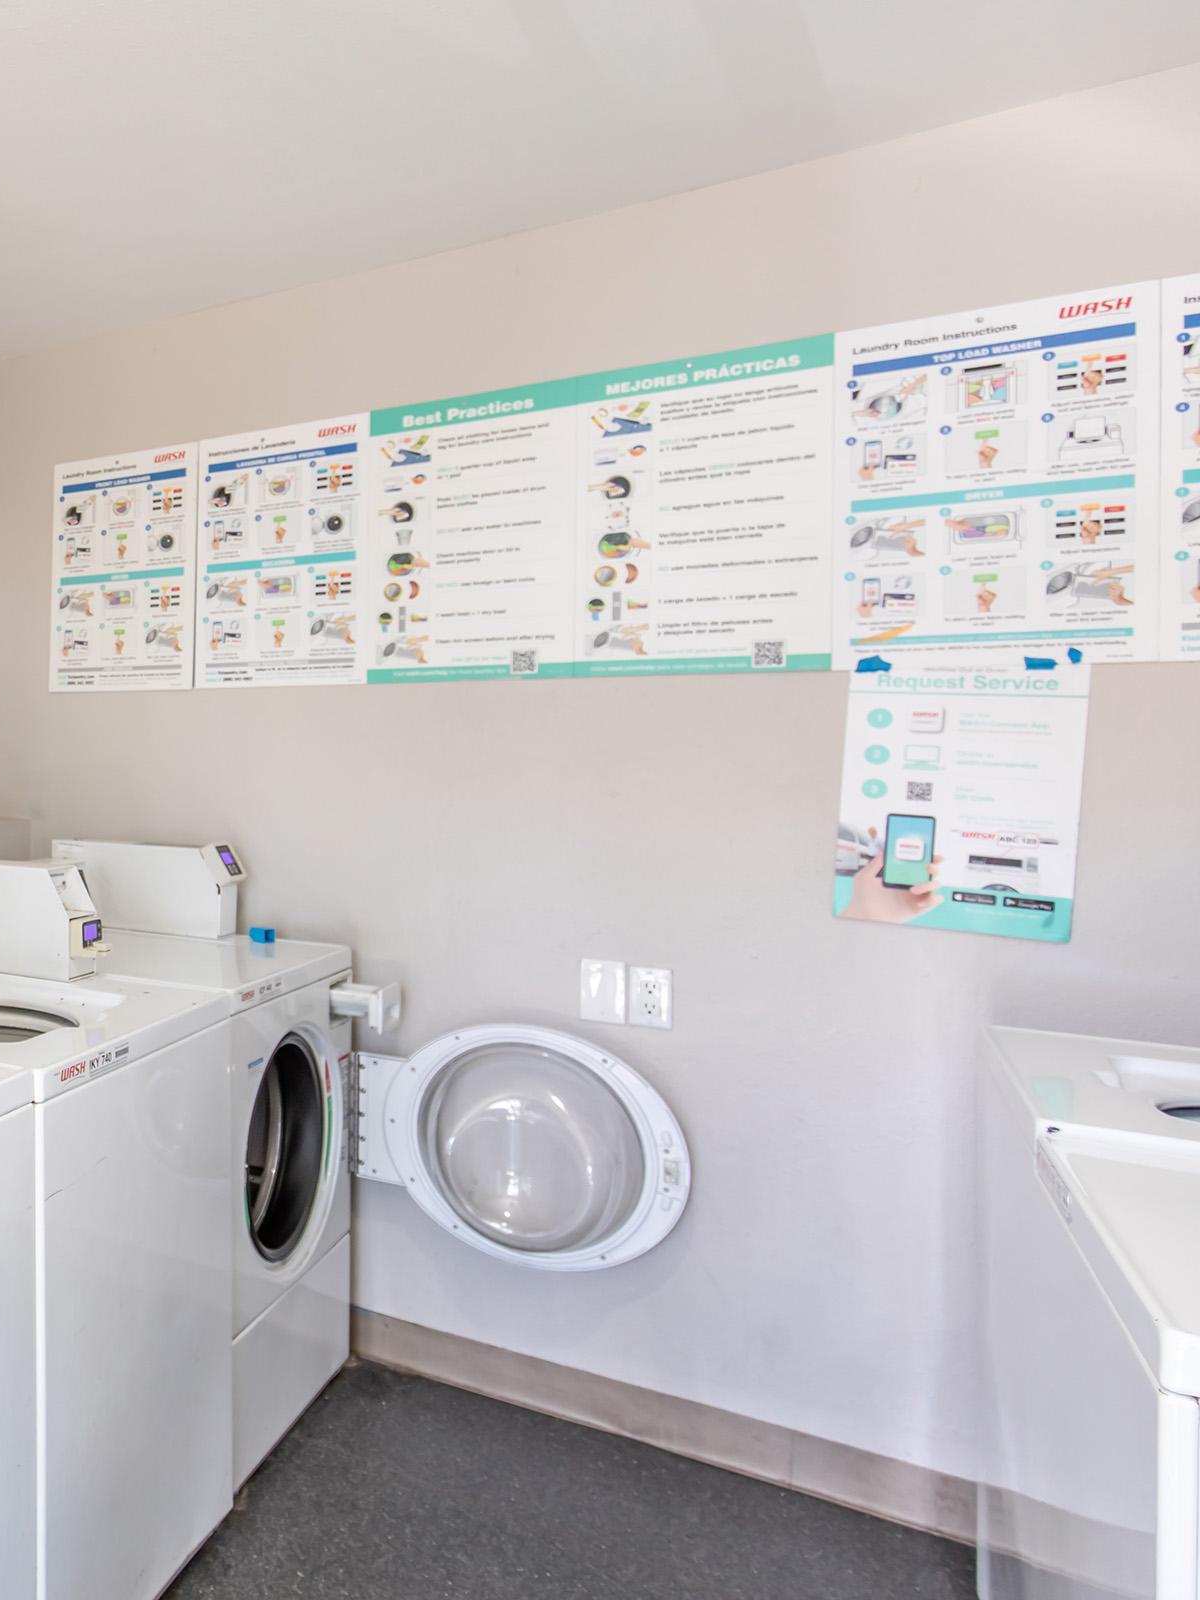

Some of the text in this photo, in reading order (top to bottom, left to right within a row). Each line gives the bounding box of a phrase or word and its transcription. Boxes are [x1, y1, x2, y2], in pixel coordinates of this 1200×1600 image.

[1059, 296, 1131, 319] WASH
[852, 323, 1017, 355] Laundry Room Instructions
[933, 339, 1041, 362] TOP LOAD WASHER
[606, 354, 799, 395] MEJORES PRÁCTICAS
[402, 397, 533, 427] Best Practices
[318, 423, 355, 438] WASH
[154, 450, 185, 463] WASH
[877, 674, 1060, 691] Request Service
[61, 1060, 86, 1082] WASH
